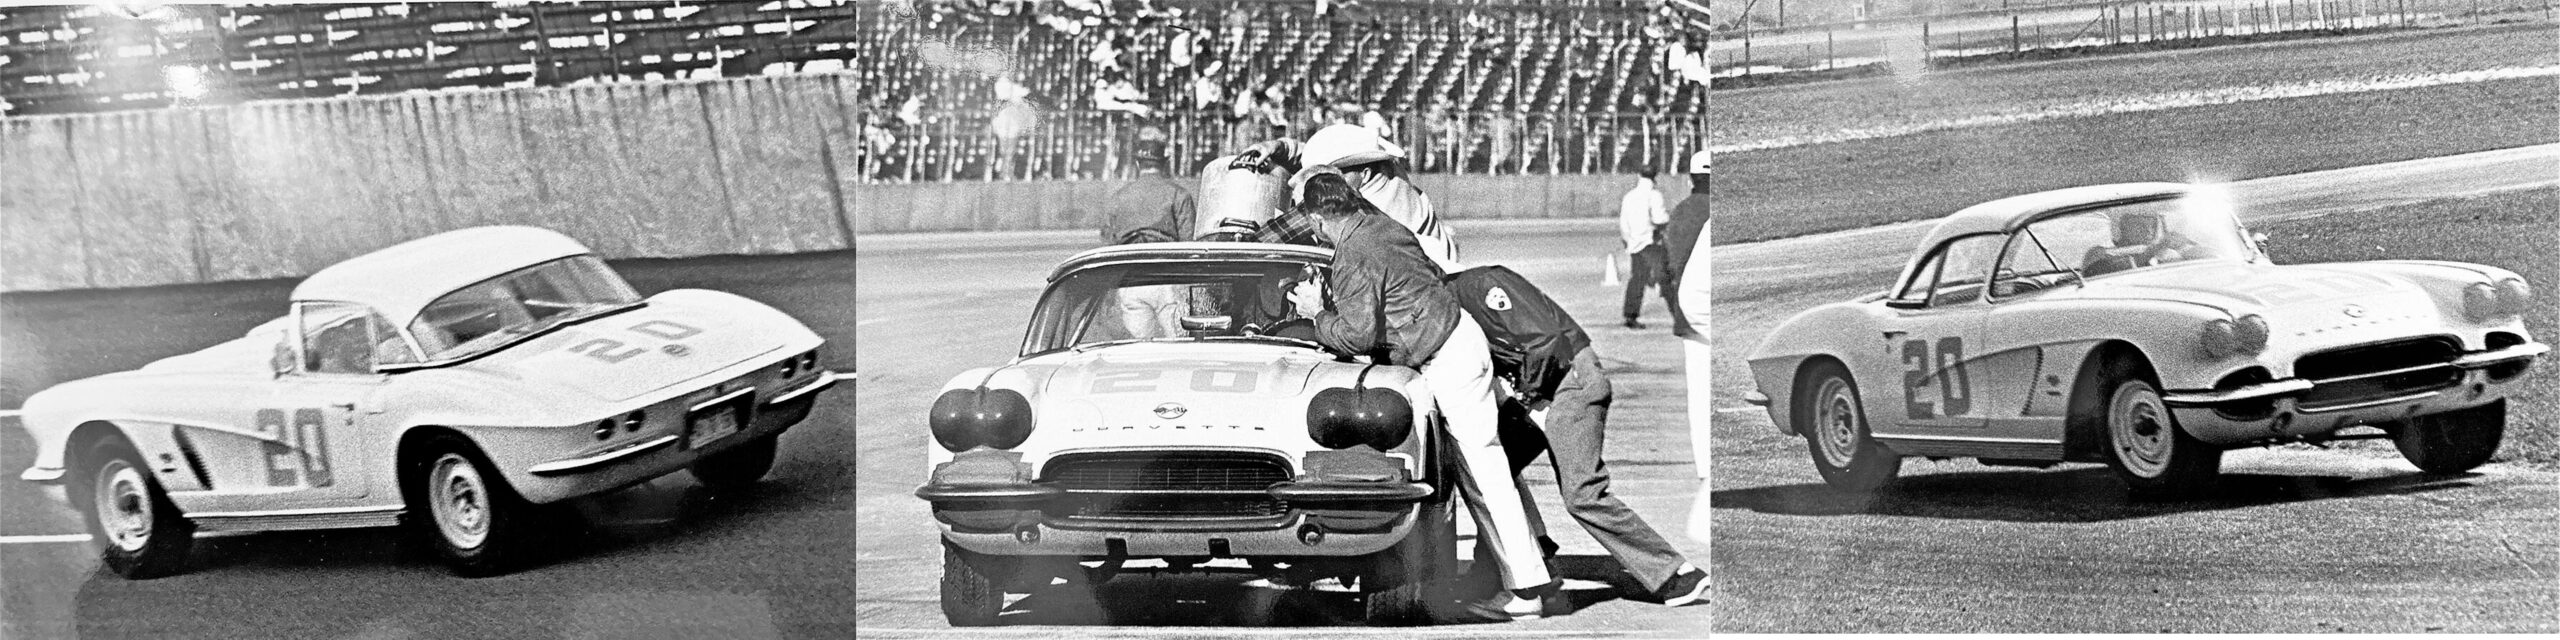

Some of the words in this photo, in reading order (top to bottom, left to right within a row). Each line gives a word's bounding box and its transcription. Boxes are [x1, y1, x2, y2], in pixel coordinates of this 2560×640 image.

[568, 320, 704, 363] 20
[1090, 369, 1258, 394] 20
[1902, 336, 1971, 420] 20
[256, 408, 334, 488] 20
